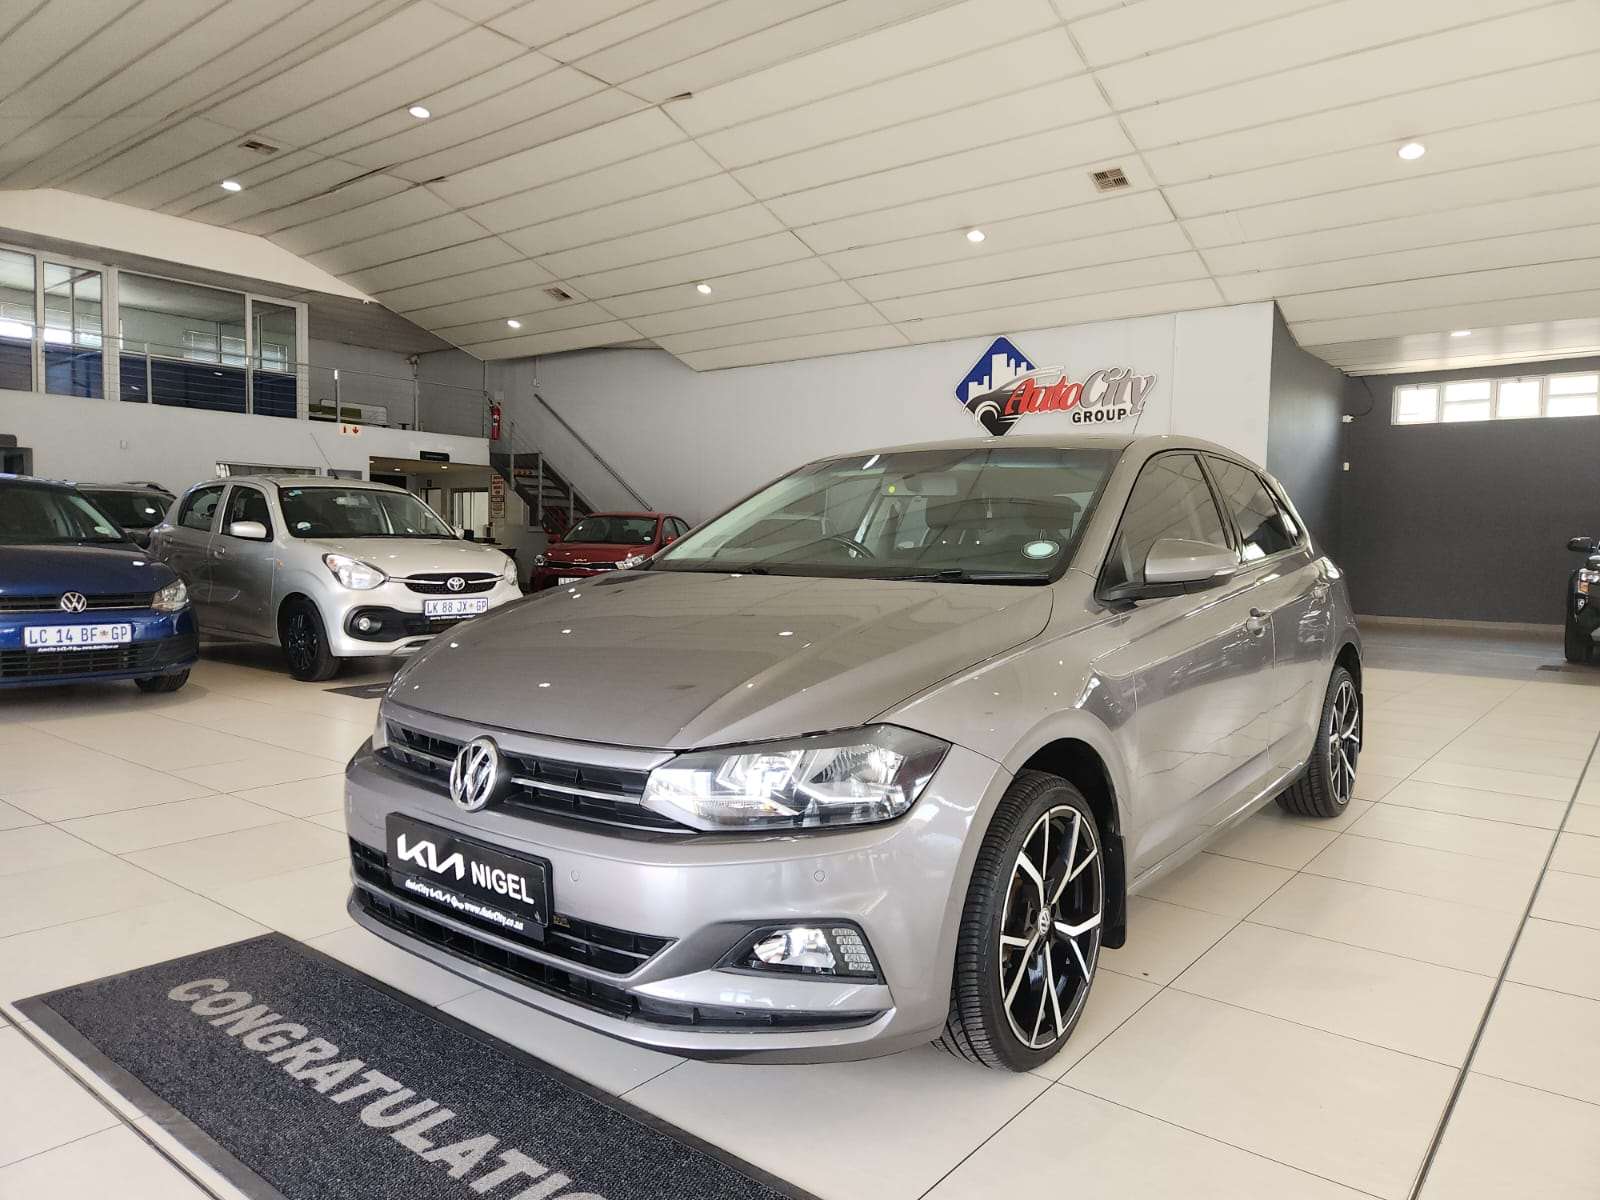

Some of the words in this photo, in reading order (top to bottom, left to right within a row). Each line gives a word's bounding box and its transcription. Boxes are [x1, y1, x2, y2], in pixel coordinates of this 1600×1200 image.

[1003, 367, 1156, 416] AutoCity
[1072, 408, 1127, 423] GROUP
[426, 602, 438, 614] LK
[442, 602, 453, 613] 88
[456, 601, 467, 612] JX
[476, 600, 487, 611] GP
[29, 629, 48, 645] LC
[57, 628, 73, 643] 14
[81, 627, 98, 642] BF
[111, 626, 128, 640] GP
[396, 833, 466, 881] KIA
[470, 860, 535, 905] NIGEL
